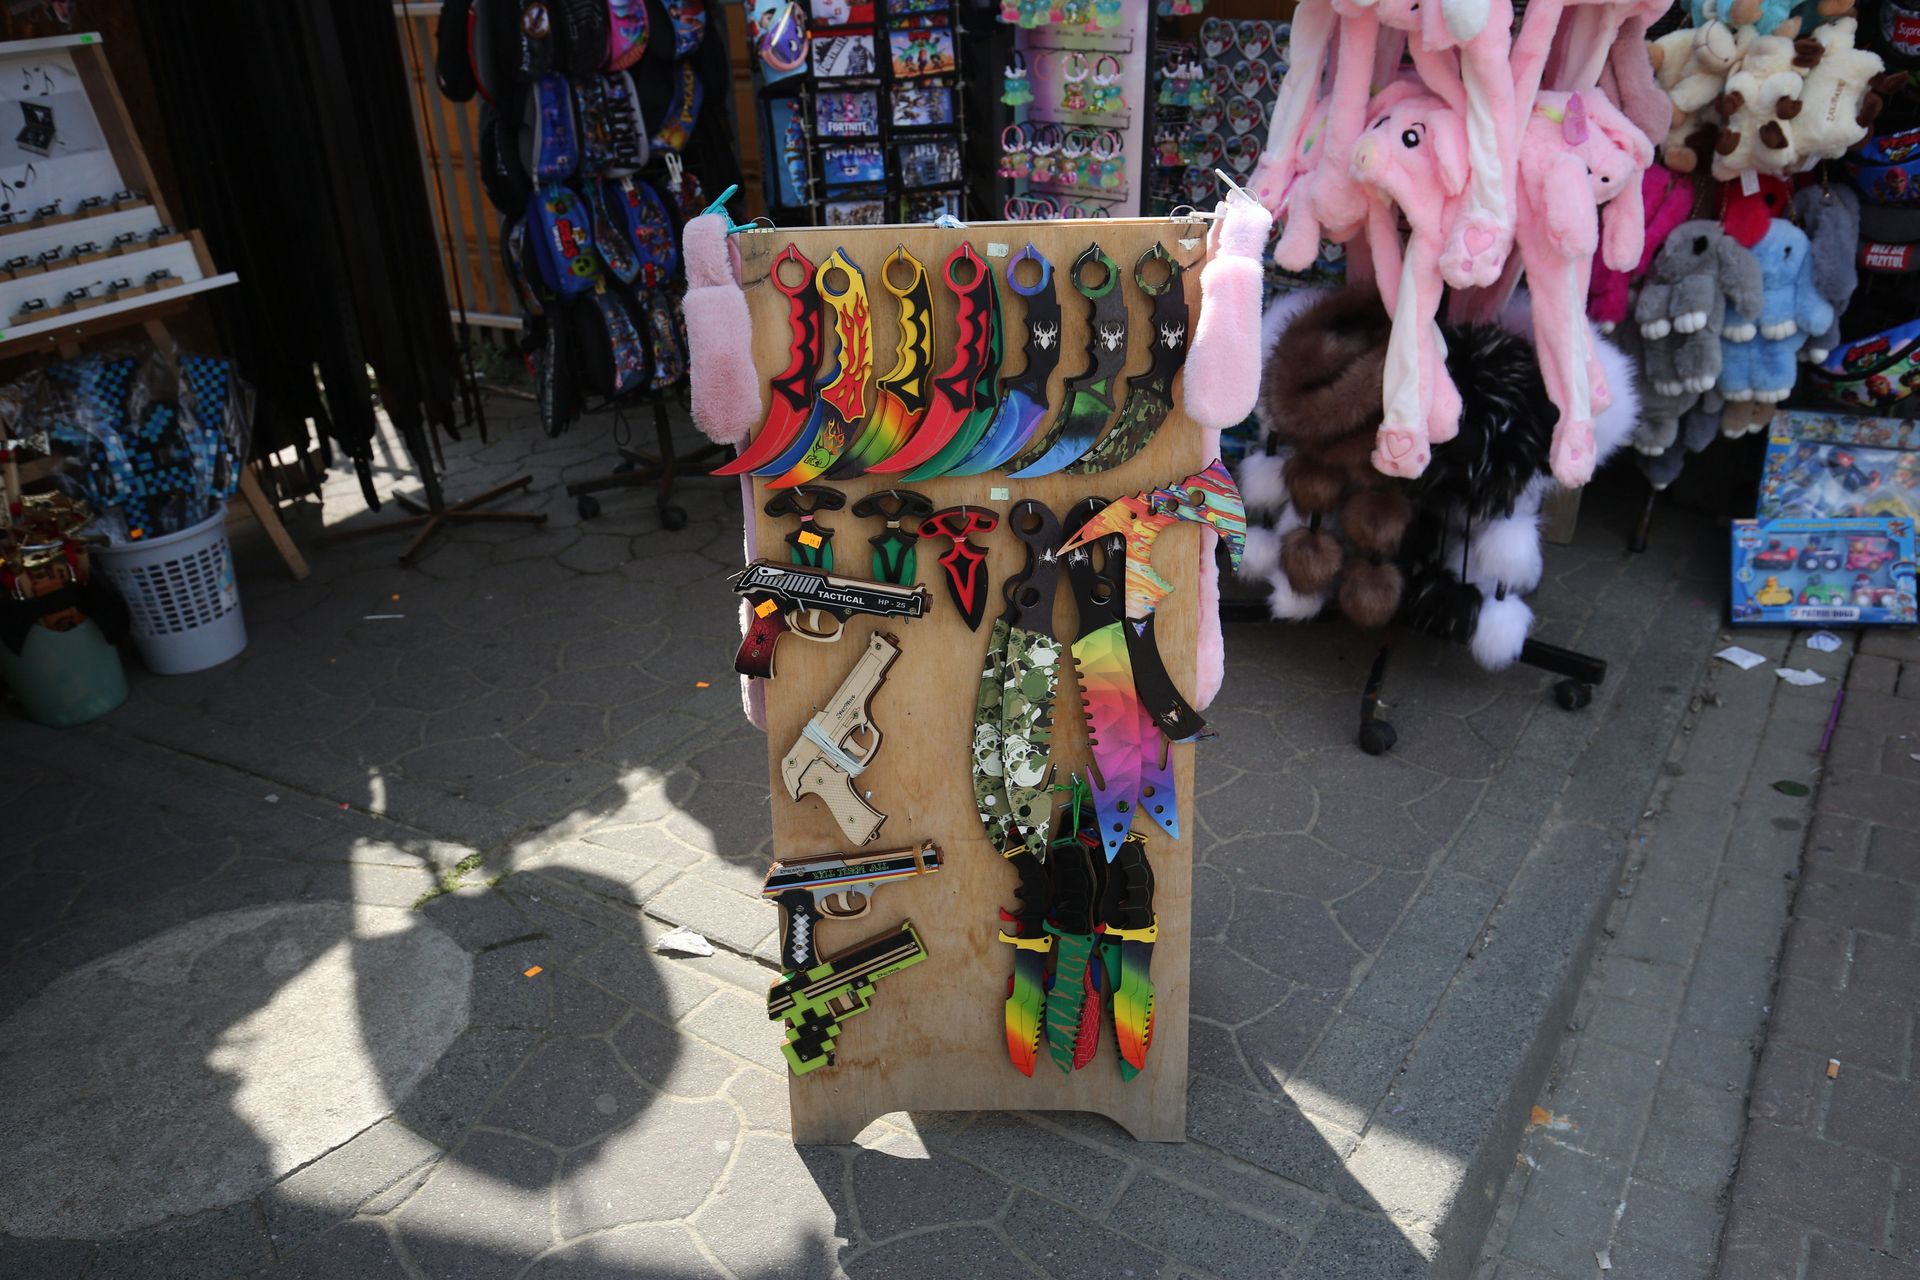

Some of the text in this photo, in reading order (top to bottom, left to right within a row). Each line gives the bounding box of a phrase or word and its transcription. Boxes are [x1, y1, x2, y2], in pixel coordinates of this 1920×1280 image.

[828, 121, 867, 133] FORTNITE
[817, 590, 865, 605] TACTICAL
[878, 597, 890, 606] HP
[896, 601, 906, 609] 25
